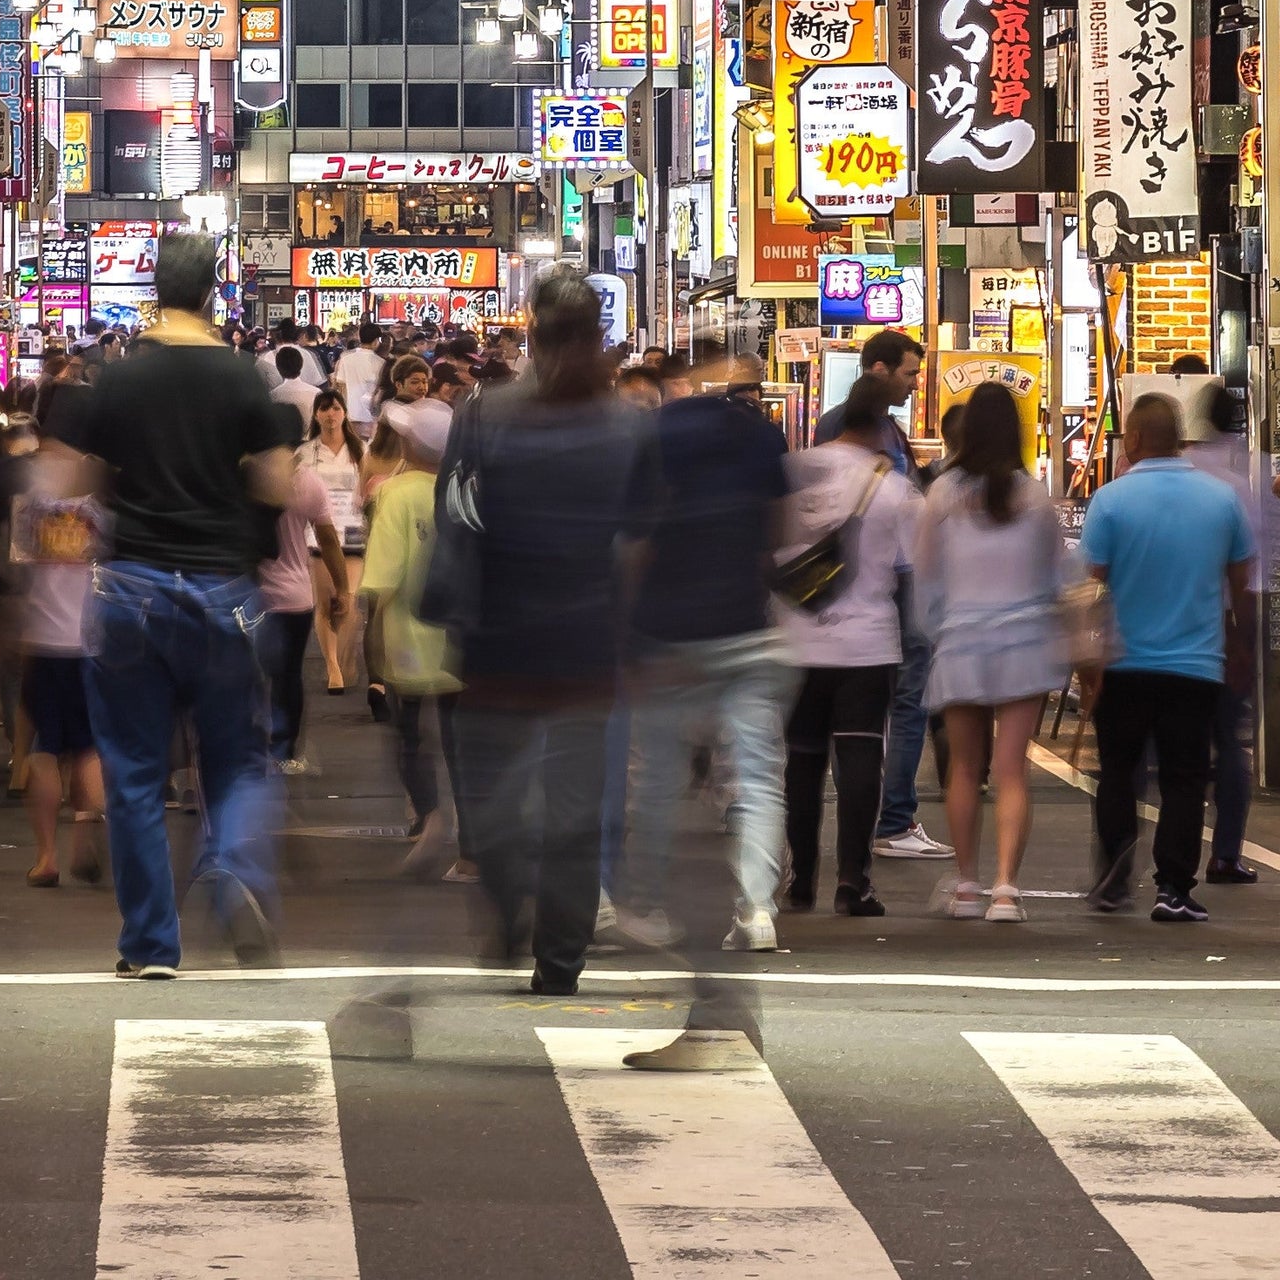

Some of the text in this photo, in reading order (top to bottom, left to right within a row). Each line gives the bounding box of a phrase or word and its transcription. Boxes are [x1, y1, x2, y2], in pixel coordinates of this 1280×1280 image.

[110, 1, 226, 28] メンズサウナ
[790, 9, 850, 59] 新宿の
[549, 105, 600, 128] 完全
[1092, 78, 1112, 178] TEPPANYAKI
[573, 129, 624, 152] 個室
[321, 156, 406, 180] コーヒー
[468, 155, 509, 181] クール
[825, 142, 897, 174] 190円
[762, 246, 808, 259] ONLINE
[1142, 228, 1196, 254] B1F
[96, 252, 156, 273] ゲーム
[310, 251, 462, 277] 無料案内所
[796, 266, 811, 278] B1
[952, 364, 1032, 391] リーチ麻雀
